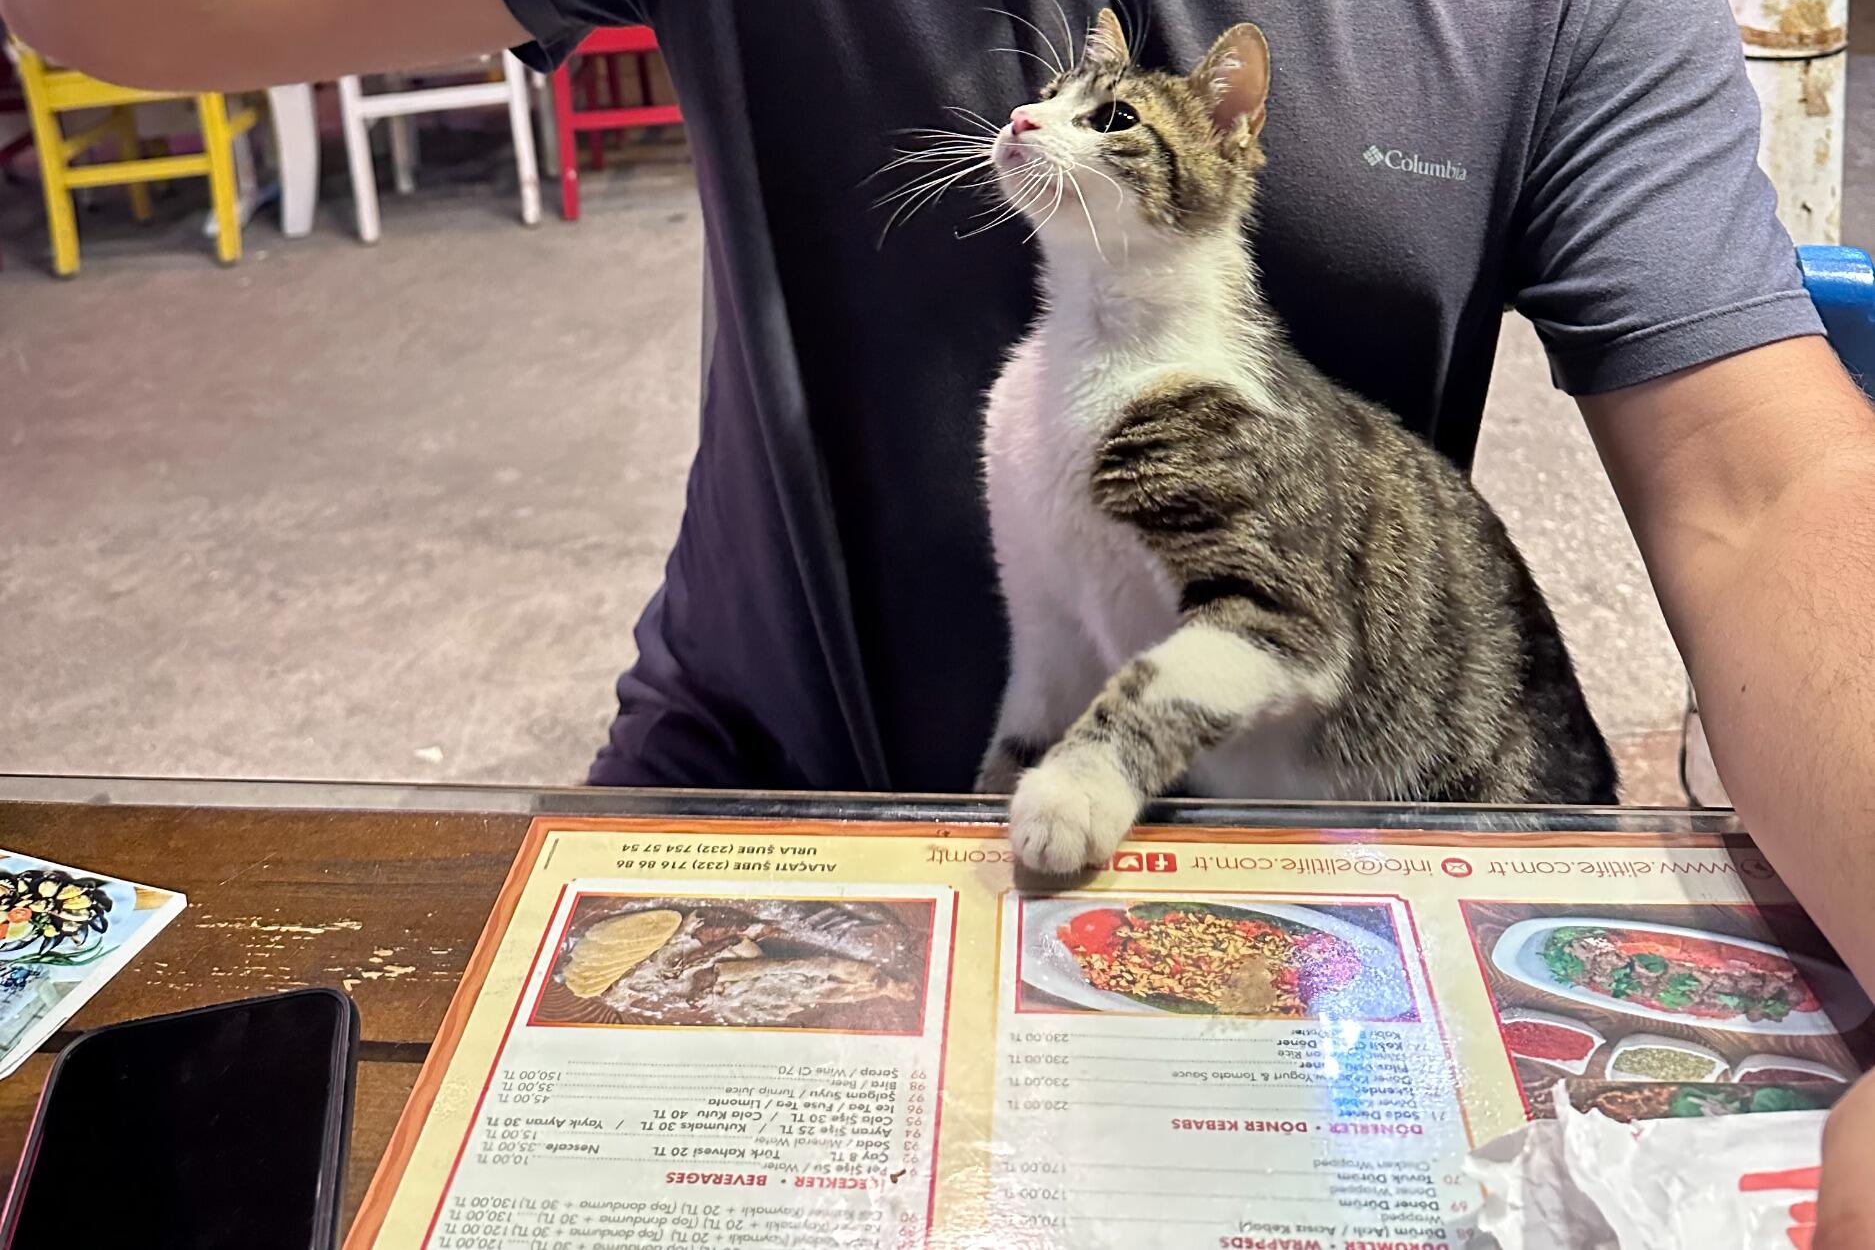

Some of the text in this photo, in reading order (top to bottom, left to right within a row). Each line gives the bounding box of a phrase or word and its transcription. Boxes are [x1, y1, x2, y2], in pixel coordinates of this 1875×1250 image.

[1384, 150, 1467, 180] Columbia
[622, 844, 817, 855] URLA ŞUBE (232) 754 57 54
[617, 860, 837, 872] ALAÇATI ŞUBE (232) 716 86 86
[1190, 856, 1433, 876] info@elitlife.com.tr
[1487, 860, 1737, 878] www.elitlife.com.tr
[1276, 1039, 1317, 1049] Döner
[1025, 1054, 1069, 1064] 230,00
[1277, 1050, 1302, 1060] Rice
[504, 1070, 515, 1080] TL
[519, 1070, 562, 1081] 150,00
[778, 1065, 794, 1075] 70
[860, 1067, 899, 1079] Şarap
[1025, 1076, 1069, 1087] 230,00
[1172, 1071, 1256, 1082] Tomato Sauce
[502, 1081, 513, 1091] TL
[517, 1081, 554, 1092] 35,00
[870, 1080, 897, 1090] Bira
[909, 1082, 925, 1091] 98
[725, 1086, 756, 1096] Juice
[758, 1086, 795, 1098] Turnip
[809, 1089, 841, 1100] Suyu
[846, 1090, 896, 1102] Şalgam
[498, 1093, 923, 1114] 96 Ice Tea Fuse Tea Limonta 45,00 TL
[1024, 1100, 1069, 1111] 220,00
[486, 1117, 499, 1127] TL
[504, 1117, 521, 1127] 30
[525, 1116, 566, 1128] Ayran
[653, 1110, 922, 1126] 95 Cola Şişe 30 TL Cola Kutu 40 TL
[640, 1121, 654, 1131] TL
[659, 1122, 677, 1131] 30
[680, 1121, 747, 1133] Kutumaks
[779, 1125, 793, 1135] TL
[798, 1126, 815, 1136] 25
[1171, 1118, 1423, 1138] DÖNERLER DÖNER KEBABS
[486, 1129, 497, 1139] TL
[501, 1129, 537, 1141] 15,00
[851, 1126, 892, 1138] Ayran
[482, 1141, 494, 1151] TL
[545, 1143, 600, 1154] Nescafe
[856, 1140, 890, 1150] Soda
[652, 1147, 666, 1156] TL
[671, 1147, 689, 1156] 20
[692, 1147, 746, 1158] Kahvesi
[750, 1149, 780, 1159] Türk
[830, 1152, 845, 1161] TL
[849, 1152, 857, 1162] 8
[862, 1151, 889, 1163] Çay
[477, 1154, 488, 1164] TL
[492, 1153, 529, 1166] 10,00
[762, 1162, 798, 1173] Water
[814, 1164, 831, 1174] Su
[665, 1172, 768, 1186] BEVERAGES
[1337, 1173, 1387, 1184] Dürüm
[455, 1197, 466, 1208] TL
[541, 1199, 560, 1210] 30
[579, 1200, 647, 1213] dondurma
[650, 1201, 677, 1215] (Top
[1338, 1199, 1390, 1210] Dürüm
[1395, 1200, 1439, 1211] Döner
[680, 1202, 698, 1215] TL)
[703, 1205, 720, 1216] 20
[449, 1209, 461, 1220] TL
[466, 1210, 512, 1222] 130,00
[560, 1214, 578, 1224] 30
[599, 1215, 668, 1227] dondurma
[672, 1216, 699, 1229] (Top
[703, 1218, 721, 1230] TL)
[726, 1219, 743, 1230] 20
[444, 1223, 456, 1234] TL
[532, 1227, 550, 1238] 30
[569, 1228, 635, 1240] dondurma
[1394, 1227, 1447, 1240] Dürüm
[637, 1229, 664, 1242] (Top
[671, 1230, 688, 1243] TL)
[692, 1232, 709, 1243] 20
[439, 1236, 451, 1248] TL
[1219, 1237, 1323, 1250] WRAPPEDS
